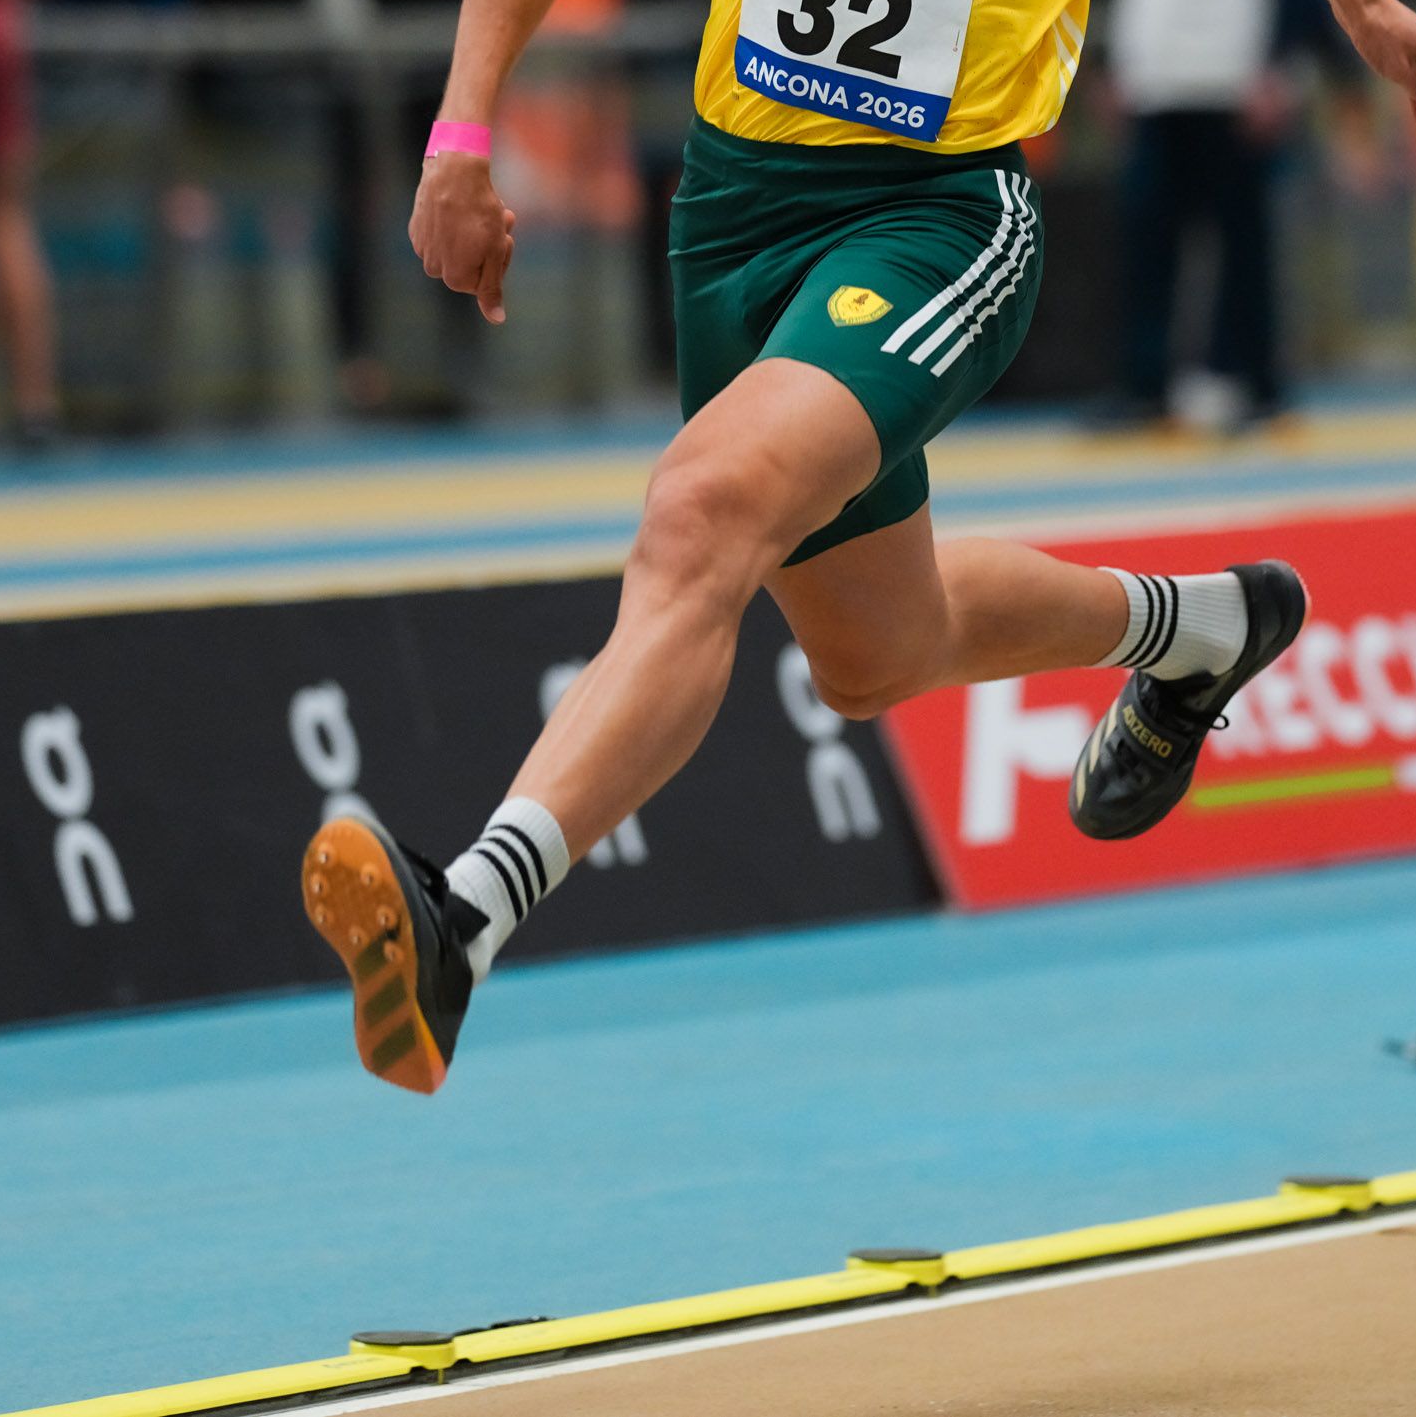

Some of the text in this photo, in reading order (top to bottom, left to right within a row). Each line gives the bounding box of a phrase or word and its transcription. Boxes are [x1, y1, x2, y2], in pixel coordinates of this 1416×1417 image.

[743, 55, 926, 129] ANCONA 2026
[1121, 704, 1174, 759] ADIZERO
